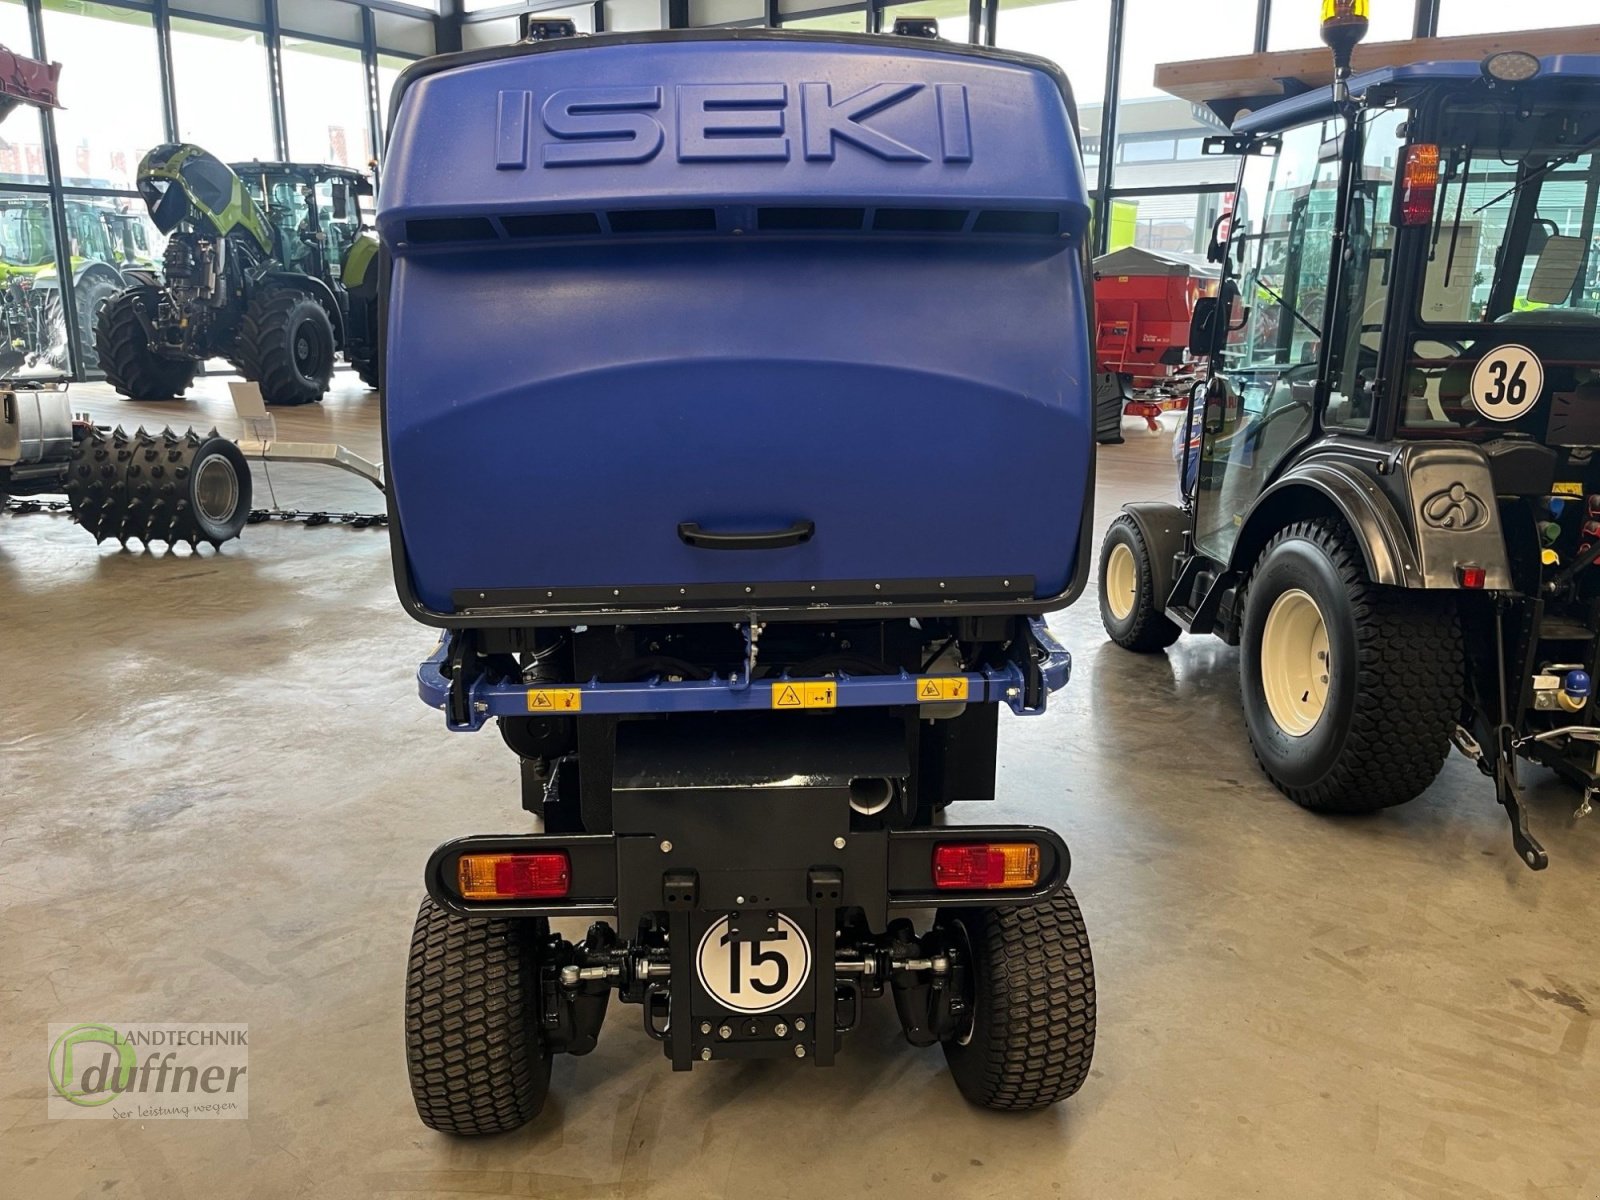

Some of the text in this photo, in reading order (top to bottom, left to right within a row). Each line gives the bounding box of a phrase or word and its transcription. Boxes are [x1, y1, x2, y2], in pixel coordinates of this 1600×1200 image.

[495, 82, 973, 170] ISEKI
[1485, 360, 1527, 405] 36
[720, 930, 789, 994] 15
